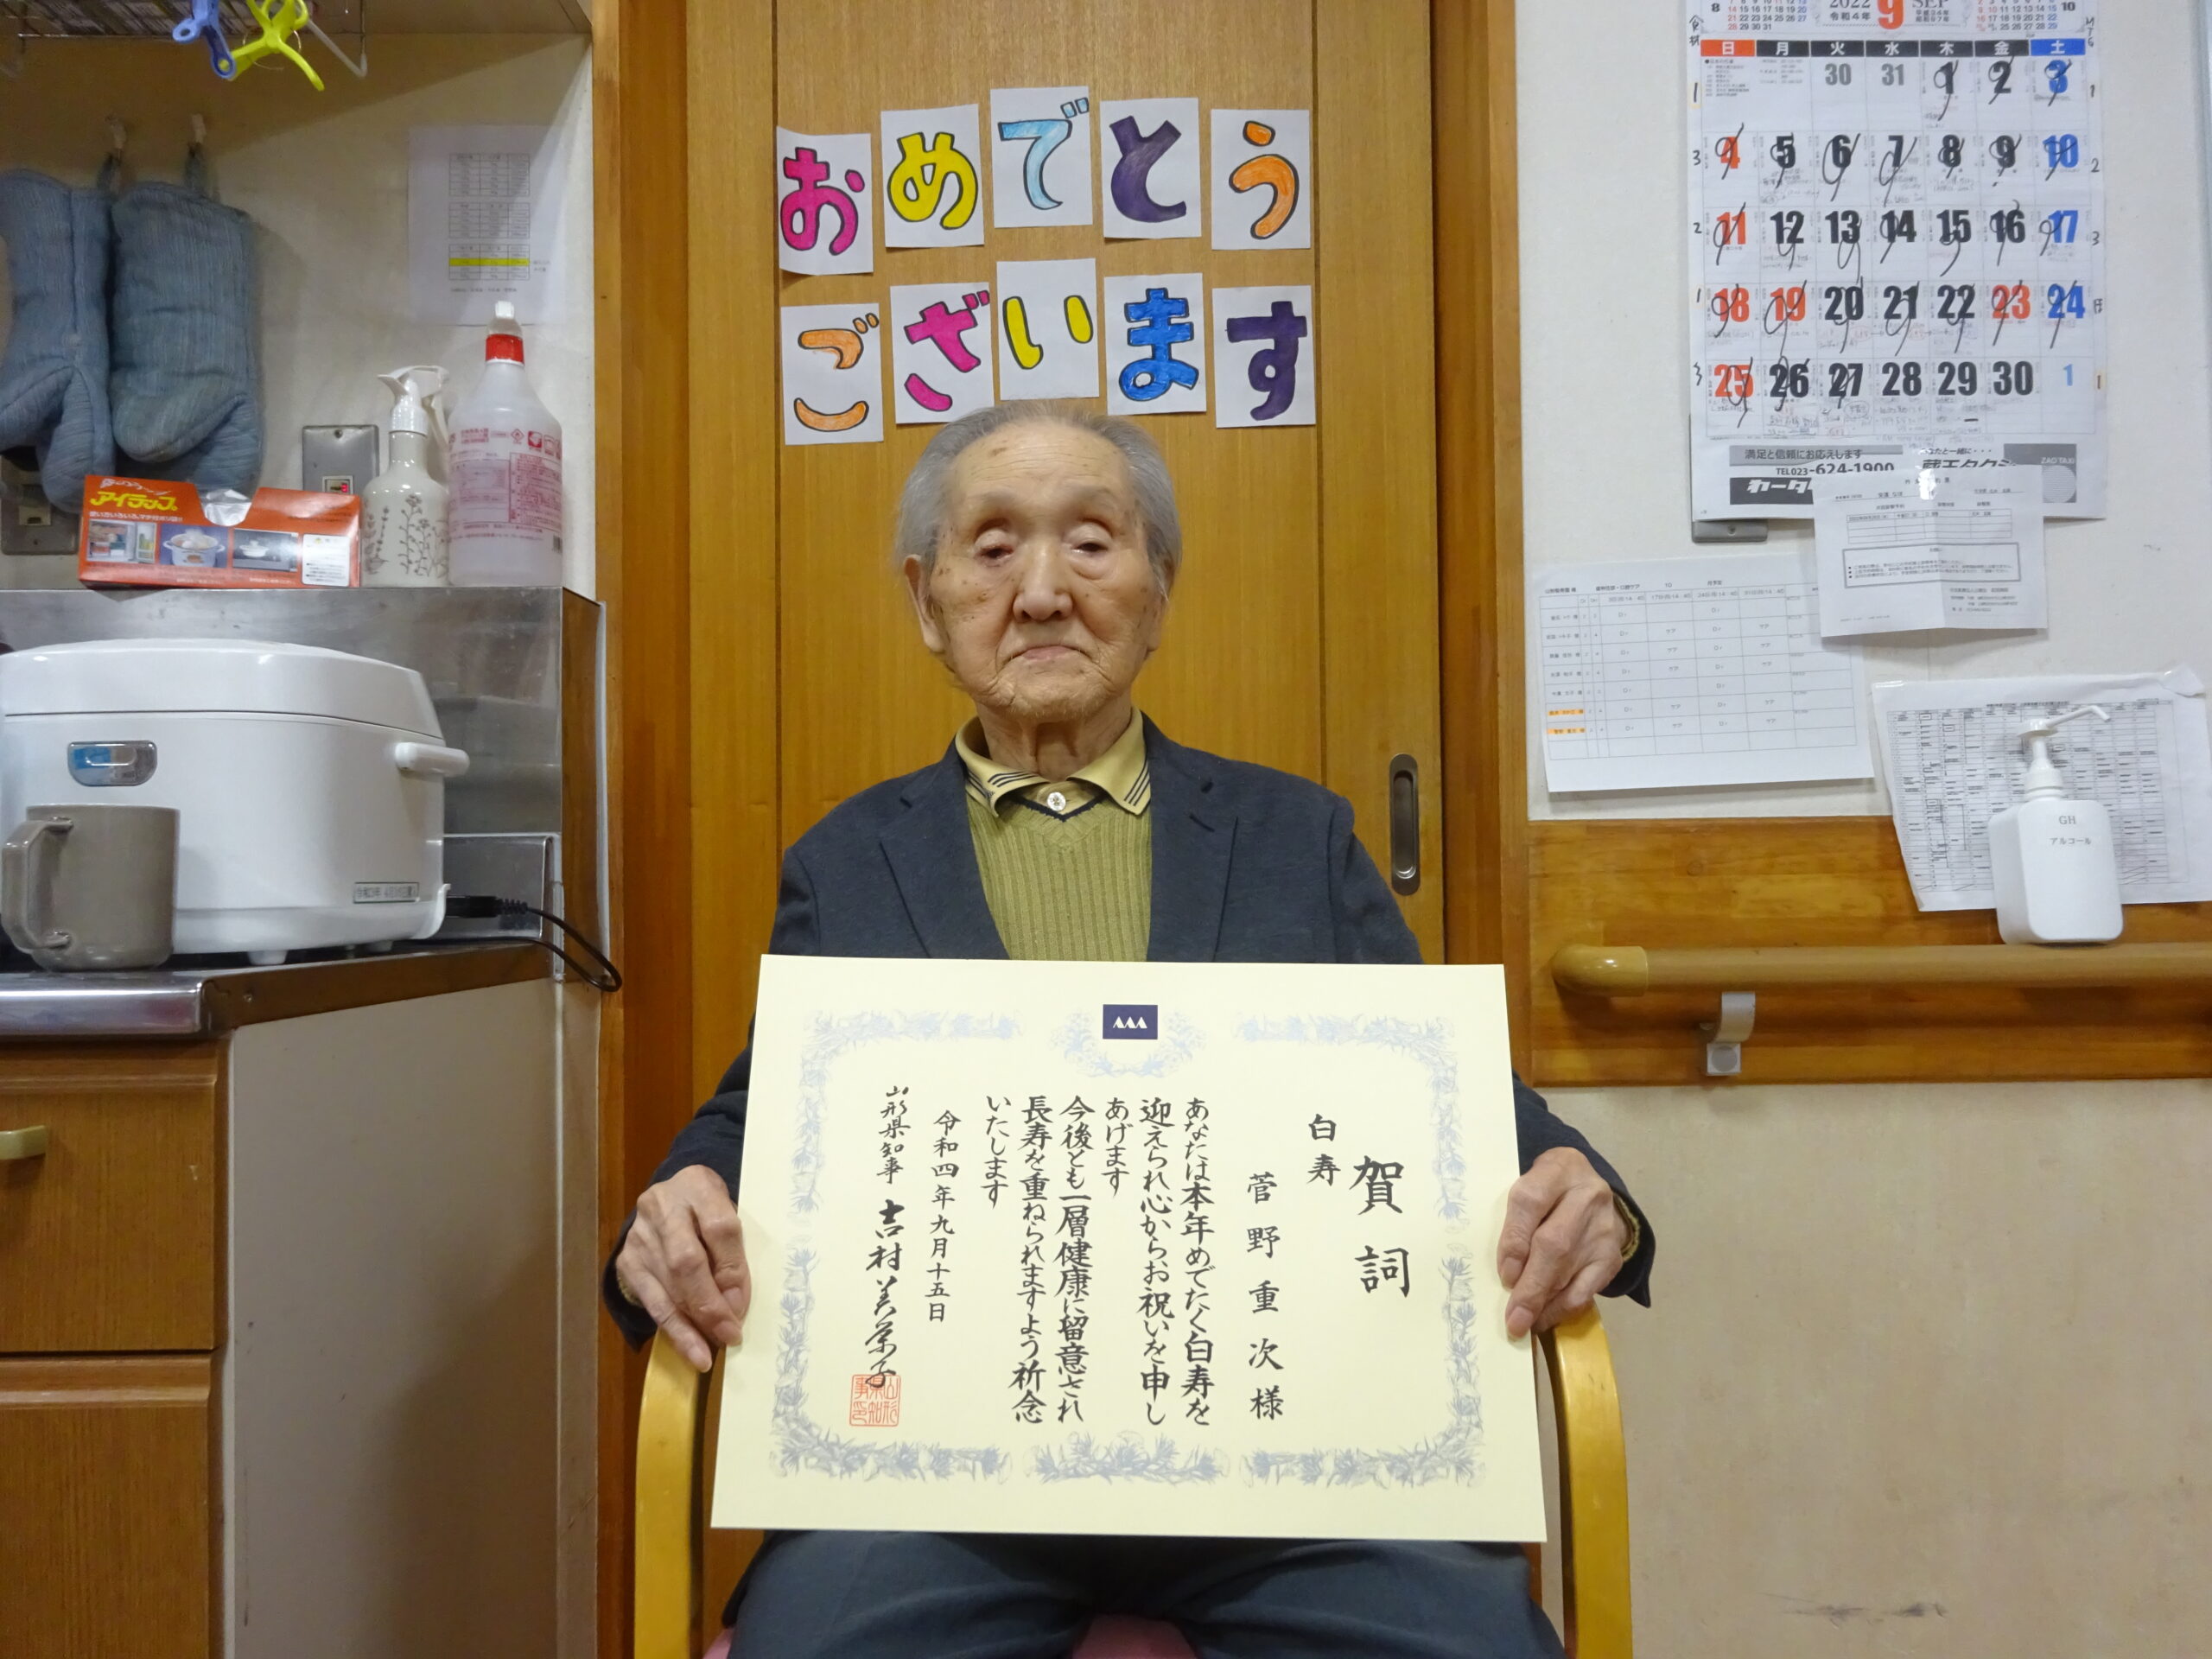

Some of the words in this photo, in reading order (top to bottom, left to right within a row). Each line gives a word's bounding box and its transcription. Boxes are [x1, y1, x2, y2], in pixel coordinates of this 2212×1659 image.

[1712, 3, 1720, 12] 8
[1830, 11, 1871, 21] 令和4年
[1878, 0, 1904, 29] 9
[2061, 2, 2075, 11] 10
[1722, 42, 1734, 54] 日
[1776, 41, 1789, 55] 月
[1830, 41, 1846, 54] 火
[1885, 41, 1899, 55] 水
[1940, 41, 1955, 54] 木
[1994, 41, 2010, 54] 金
[2050, 40, 2065, 54] 土
[1824, 63, 1852, 86] 30
[1881, 63, 1904, 86] 31
[1993, 60, 2012, 93] 2
[2048, 60, 2069, 93] 3
[1693, 150, 1701, 165] 3
[1720, 136, 1740, 168] 4
[1777, 136, 1796, 168] 5
[1831, 134, 1851, 168] 6
[1888, 135, 1904, 168] 7
[1942, 134, 1961, 168] 8
[1996, 135, 2016, 168] 9
[2043, 134, 2079, 168] 10
[2091, 157, 2100, 173] 2
[780, 97, 1300, 256] おめでとう
[1694, 222, 1702, 234] 2
[1716, 212, 1746, 245] 11
[1770, 210, 1804, 244] 12
[1825, 210, 1860, 244] 13
[1882, 210, 1916, 243] 14
[1936, 210, 1972, 243] 15
[1991, 209, 2025, 243] 16
[2048, 210, 2078, 243] 17
[2092, 231, 2100, 245] 3
[1714, 287, 1749, 322] 18
[1770, 286, 1806, 321] 19
[1824, 286, 1864, 321] 20
[1883, 285, 1916, 320] 21
[1937, 284, 1975, 319] 22
[1992, 284, 2031, 320] 23
[2048, 283, 2086, 319] 24
[794, 288, 1307, 433] ございます
[1714, 364, 1753, 397] 25
[1769, 364, 1808, 397] 26
[1828, 363, 1863, 397] 27
[1882, 362, 1922, 396] 28
[1938, 361, 1977, 396] 29
[1993, 360, 2033, 396] 30
[2063, 364, 2073, 386] 1
[1745, 448, 1862, 460] 満足と信頼にお応えします
[90, 491, 178, 511] アイラップ
[2058, 815, 2076, 824] GH
[876, 1085, 912, 1185] 山形県知事
[1101, 1096, 1134, 1198] あげます
[1306, 1113, 1341, 1187] 白寿
[980, 1095, 1012, 1210] いたします
[925, 1109, 962, 1323] 令和四年九月十五日
[1349, 1155, 1411, 1298] 賀詞
[1007, 1094, 1054, 1424] 長寿を重ねられますよう祈念
[1052, 1094, 1096, 1424] 今後とも一層健康に留意され
[1135, 1096, 1176, 1426] 迎えられ心からお祝いを申し
[1179, 1096, 1216, 1426] あなたは本年めでたく白寿を
[1247, 1171, 1284, 1421] 菅野重次様
